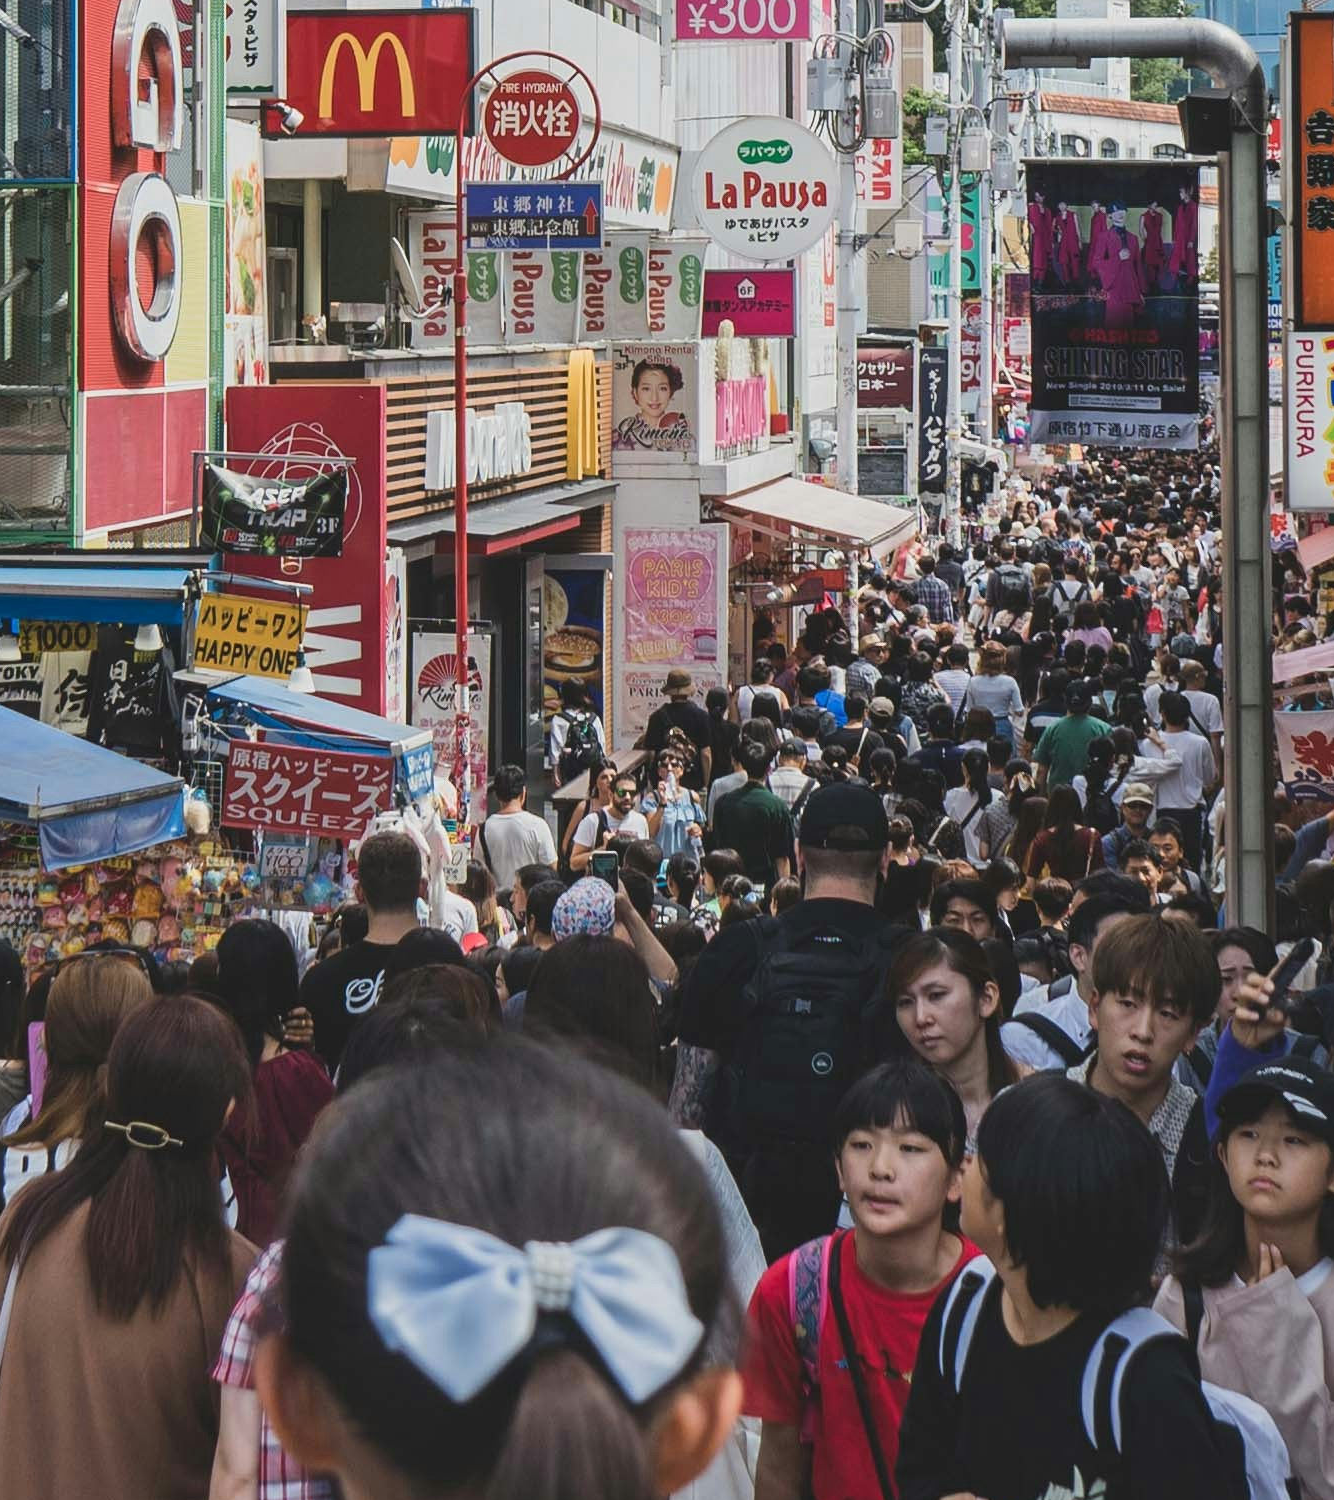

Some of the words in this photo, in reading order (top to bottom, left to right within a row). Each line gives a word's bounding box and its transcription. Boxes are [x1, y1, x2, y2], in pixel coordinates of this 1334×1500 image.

[500, 82, 520, 94] FIRE
[522, 83, 564, 95] HYDRANT
[492, 99, 573, 138] 消火栓
[491, 195, 576, 214] 東郷神社
[491, 218, 580, 237] 東郷記念館
[724, 216, 810, 231] ゆであげパスタ
[748, 230, 780, 243] &ピザ
[739, 285, 753, 296] 6F
[1295, 338, 1316, 459] PURIKURA
[247, 508, 307, 528] TRAP
[316, 516, 340, 534] 3F
[642, 558, 705, 578] PARIS
[201, 603, 303, 641] ハッピーワン
[22, 622, 92, 651] ¥1000
[194, 637, 258, 670] HAPPY
[259, 645, 298, 675] ONE
[231, 747, 390, 783] 原宿ハッピーワン
[229, 770, 389, 816] スクイーズ
[226, 803, 363, 832] SQUEEZ
